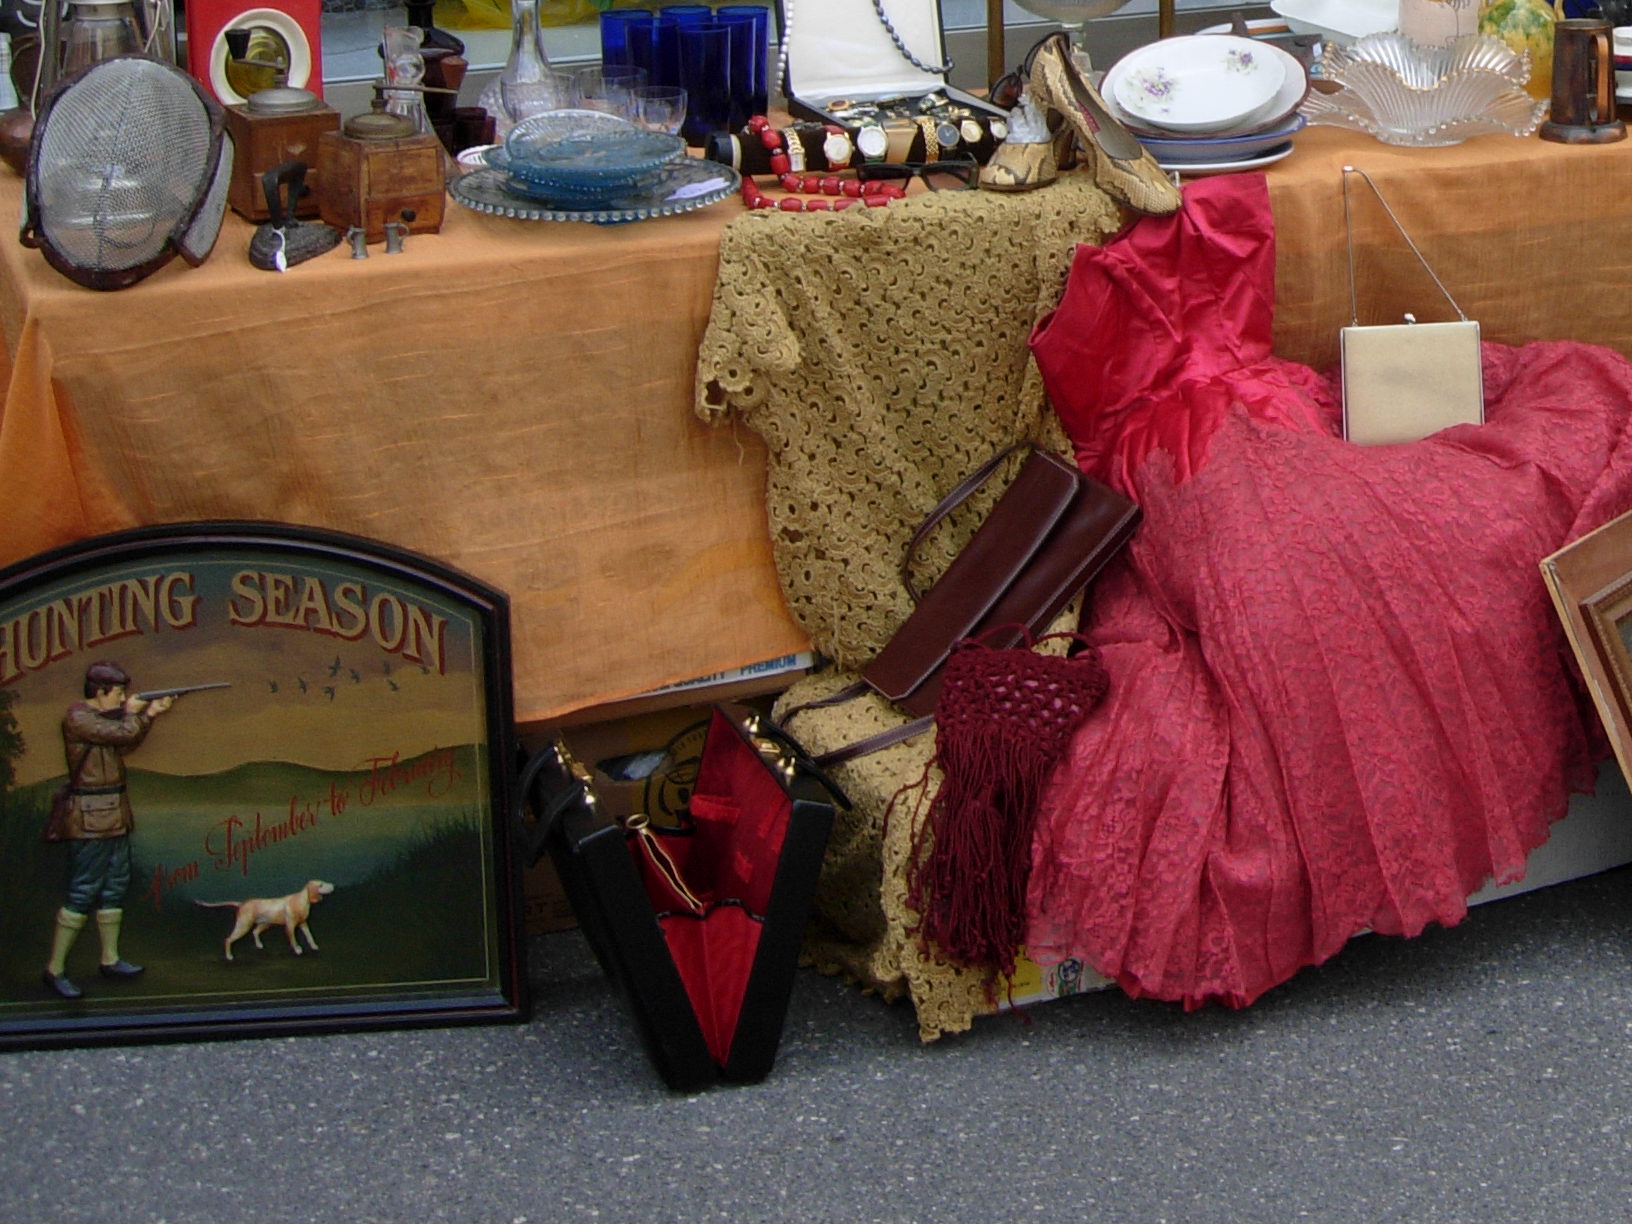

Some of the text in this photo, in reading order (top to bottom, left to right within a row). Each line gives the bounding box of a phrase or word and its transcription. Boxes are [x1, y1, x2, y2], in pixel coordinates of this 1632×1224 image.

[229, 570, 448, 674] SEASON
[139, 747, 461, 912] from September to February
